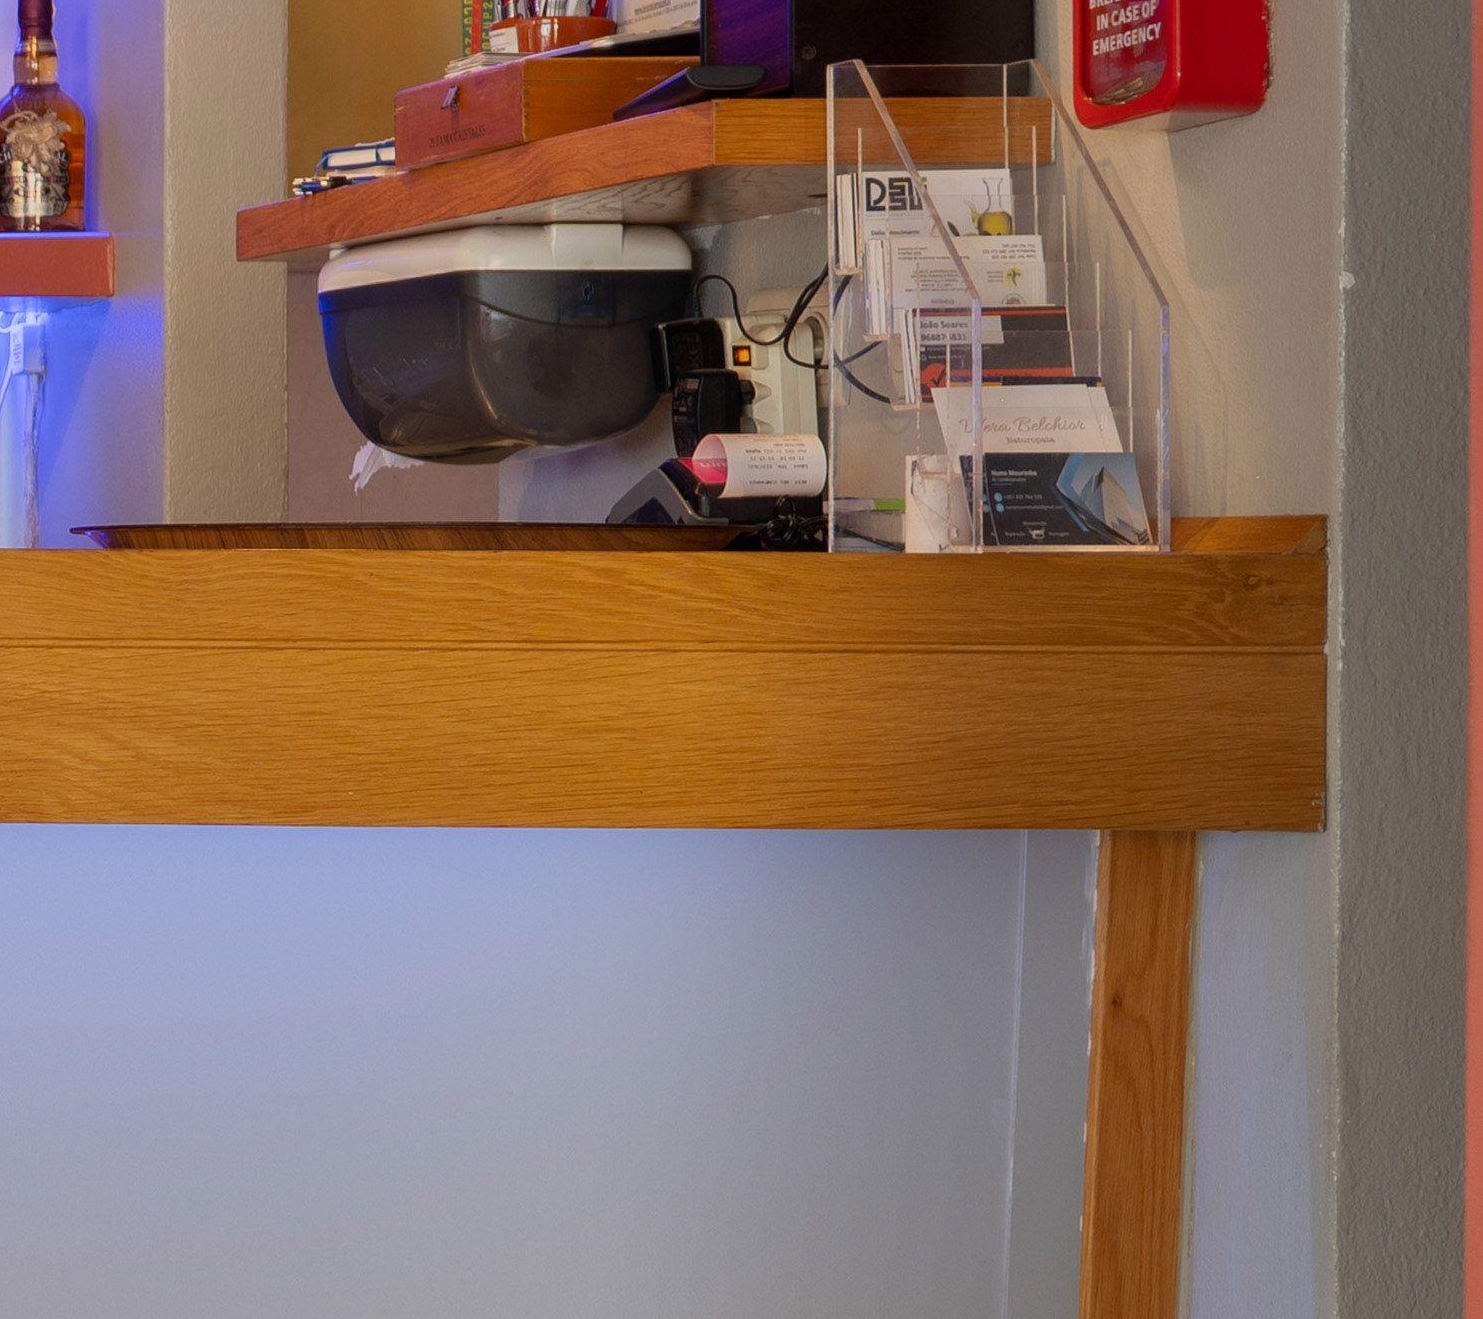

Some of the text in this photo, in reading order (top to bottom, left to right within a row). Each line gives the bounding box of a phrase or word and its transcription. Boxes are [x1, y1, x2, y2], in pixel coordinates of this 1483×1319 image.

[1097, 0, 1159, 31] IN CASE OF
[1092, 22, 1162, 56] EMERGENCY
[919, 319, 969, 330] João Soares
[1013, 416, 1085, 433] Belchior
